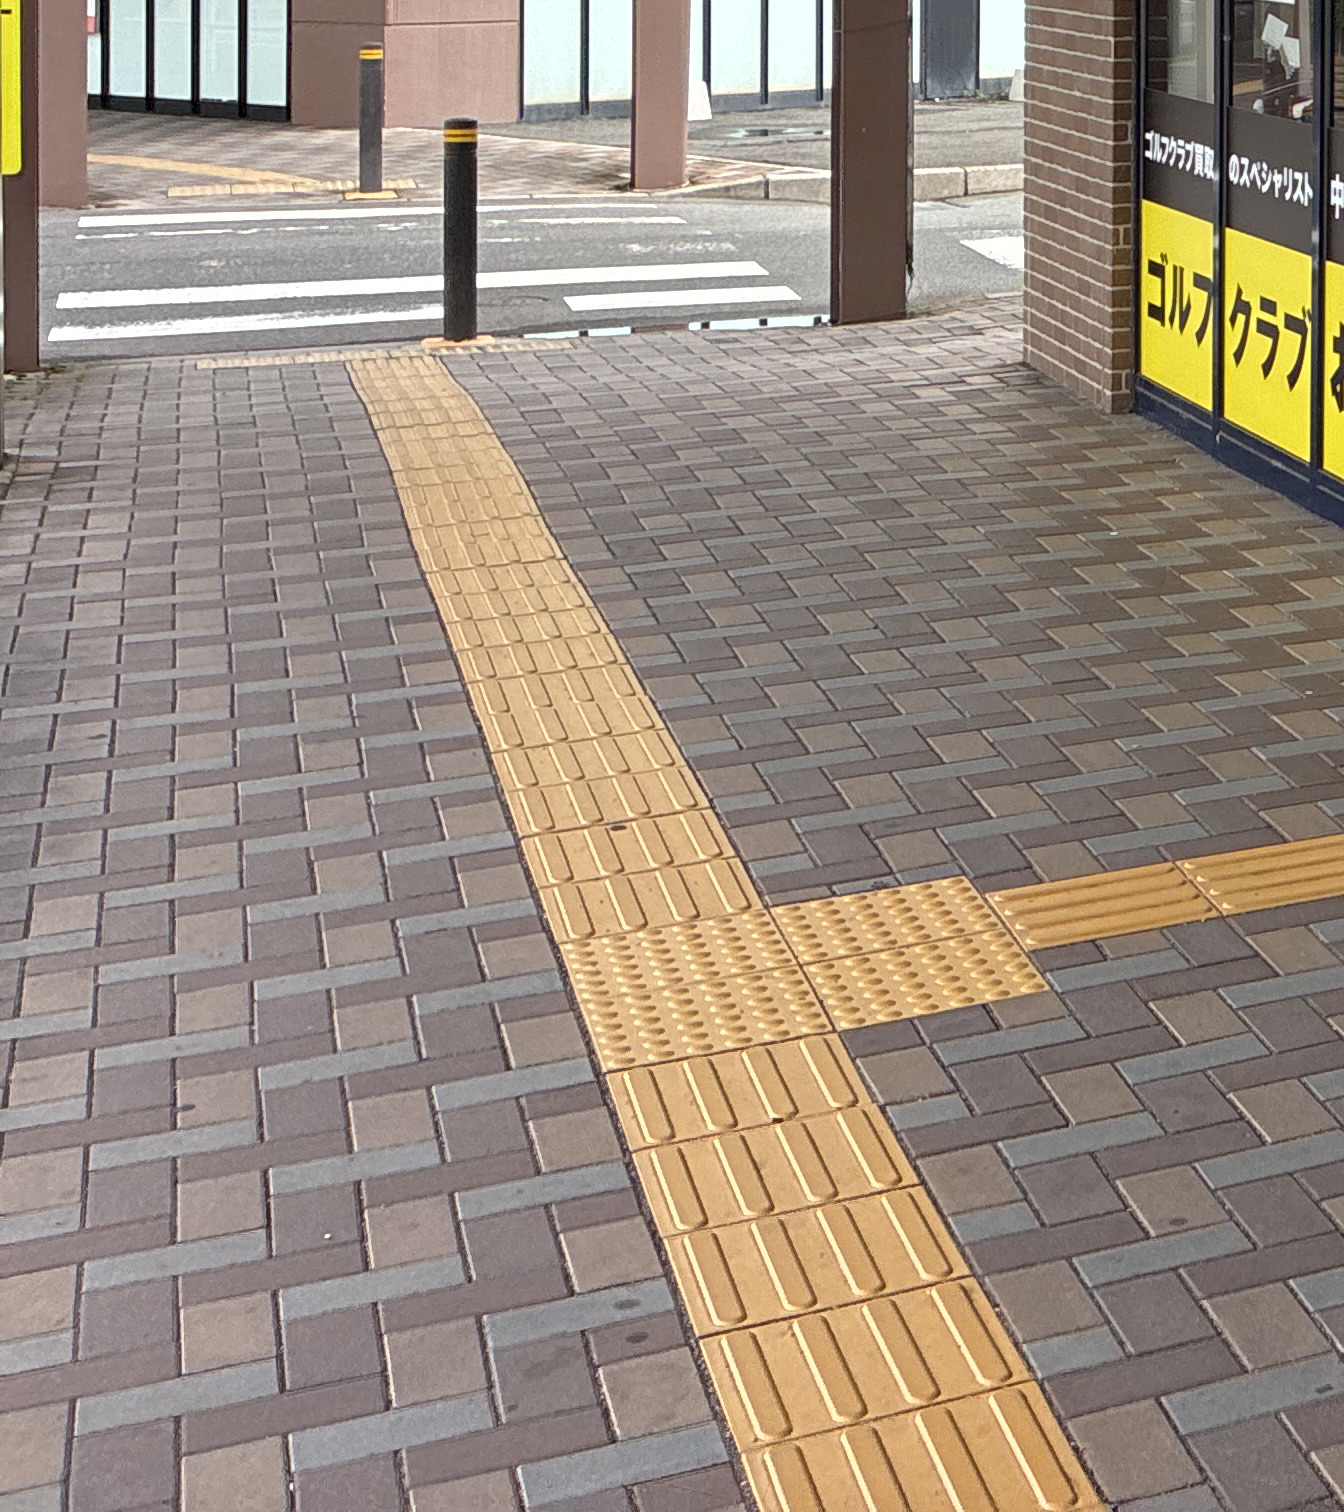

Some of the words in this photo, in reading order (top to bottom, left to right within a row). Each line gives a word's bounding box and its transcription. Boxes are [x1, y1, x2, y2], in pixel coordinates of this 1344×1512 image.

[1144, 129, 1216, 180] ゴルフクラブ買取
[1229, 154, 1314, 207] のスペシャリスト
[1229, 284, 1312, 392] クラブ
